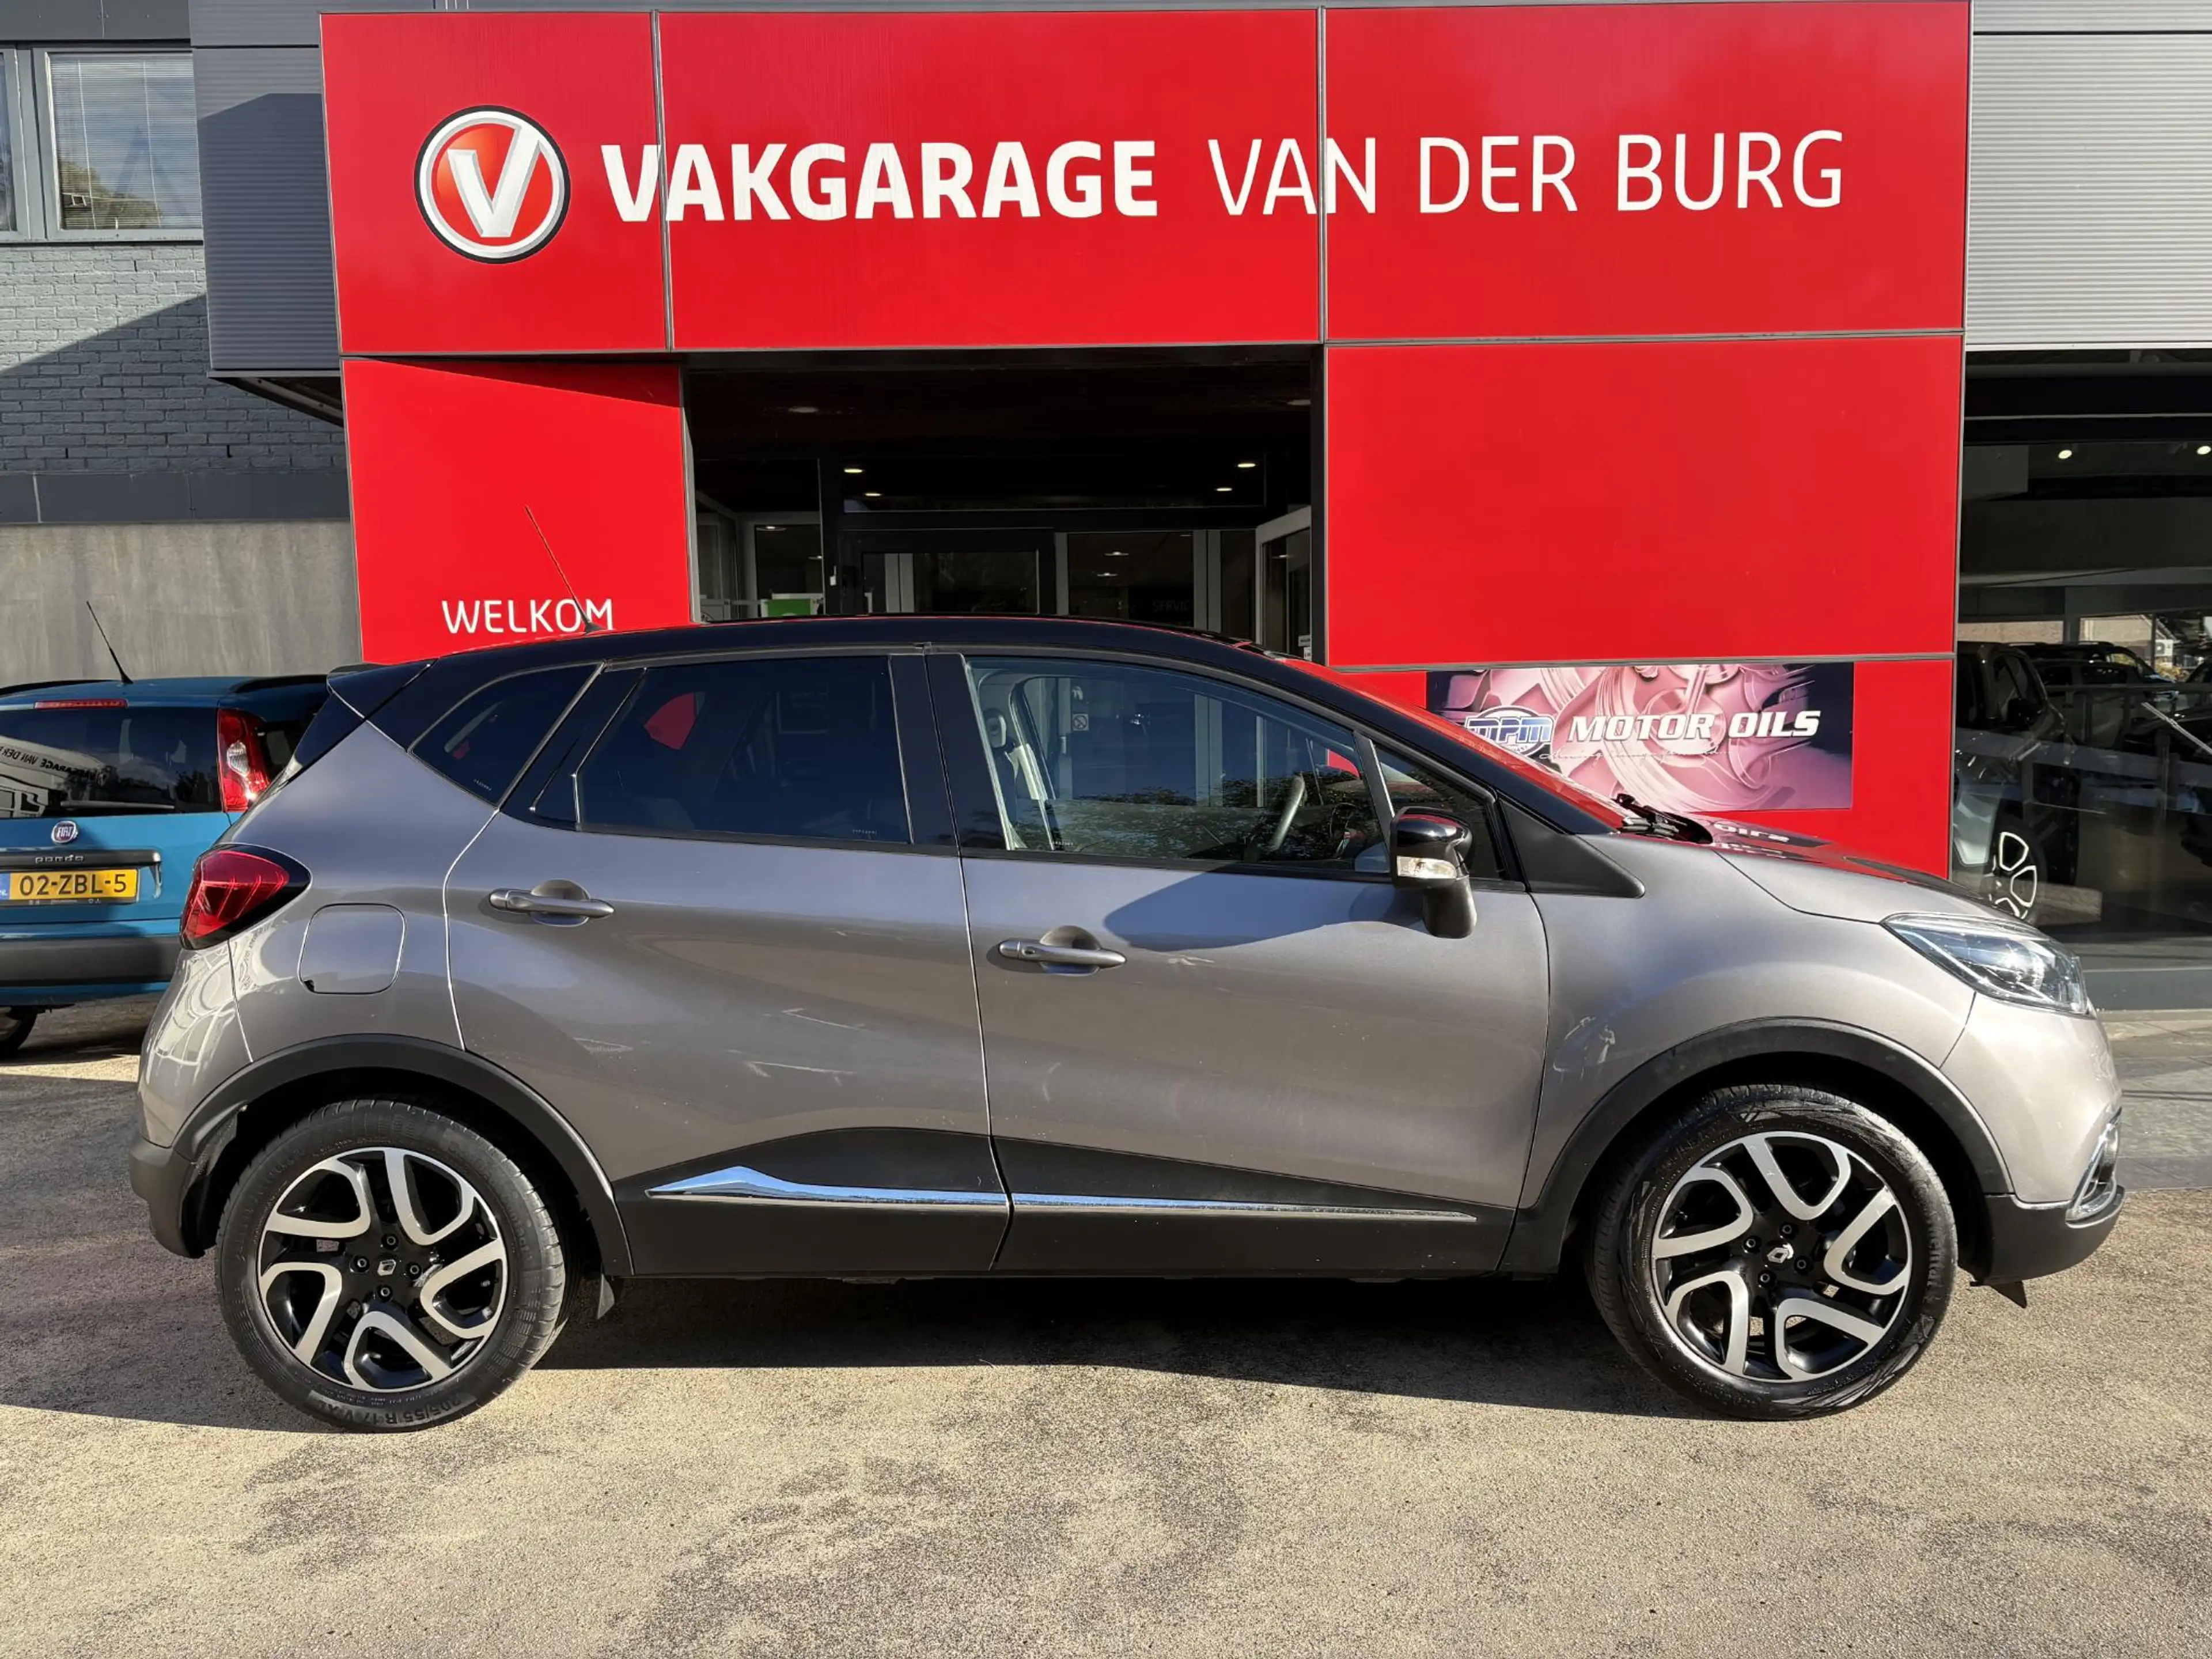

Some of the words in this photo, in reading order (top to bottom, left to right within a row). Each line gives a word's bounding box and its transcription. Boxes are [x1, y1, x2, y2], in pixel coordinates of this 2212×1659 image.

[600, 140, 1158, 222] VAKGARAGE
[1207, 137, 1376, 215] VAN
[1419, 135, 1578, 214] DER
[1617, 130, 1843, 211] BURG
[441, 599, 614, 634] WELKOM
[1567, 713, 1716, 743] MOTOR
[1728, 710, 1821, 738] OILS
[20, 873, 127, 896] 02-ZBL-5
